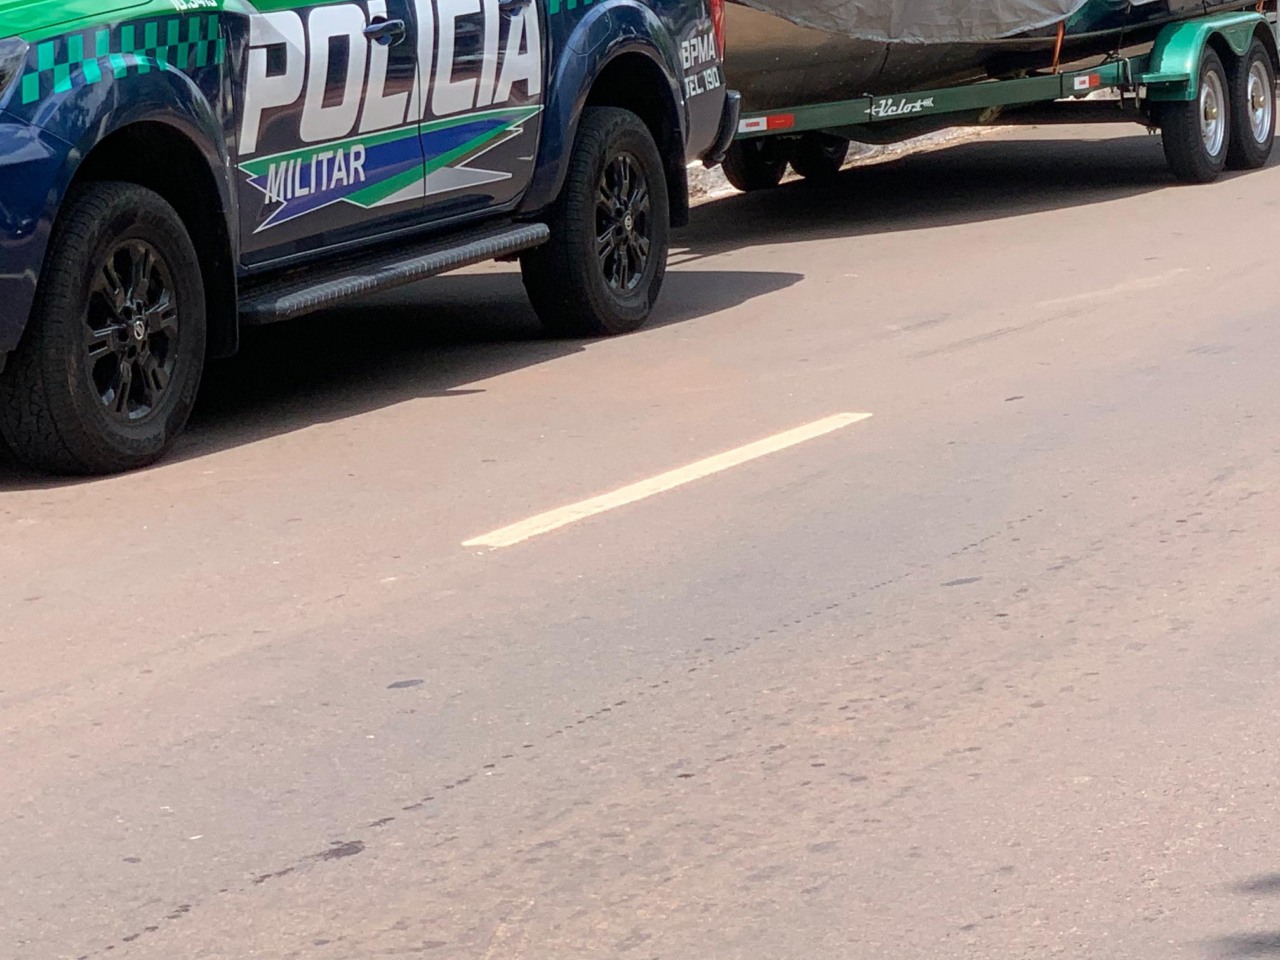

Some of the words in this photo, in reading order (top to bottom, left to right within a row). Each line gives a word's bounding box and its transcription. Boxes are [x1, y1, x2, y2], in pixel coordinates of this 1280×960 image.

[681, 33, 716, 69] BPMA
[703, 66, 721, 90] 190
[265, 144, 366, 204] MILITAR
